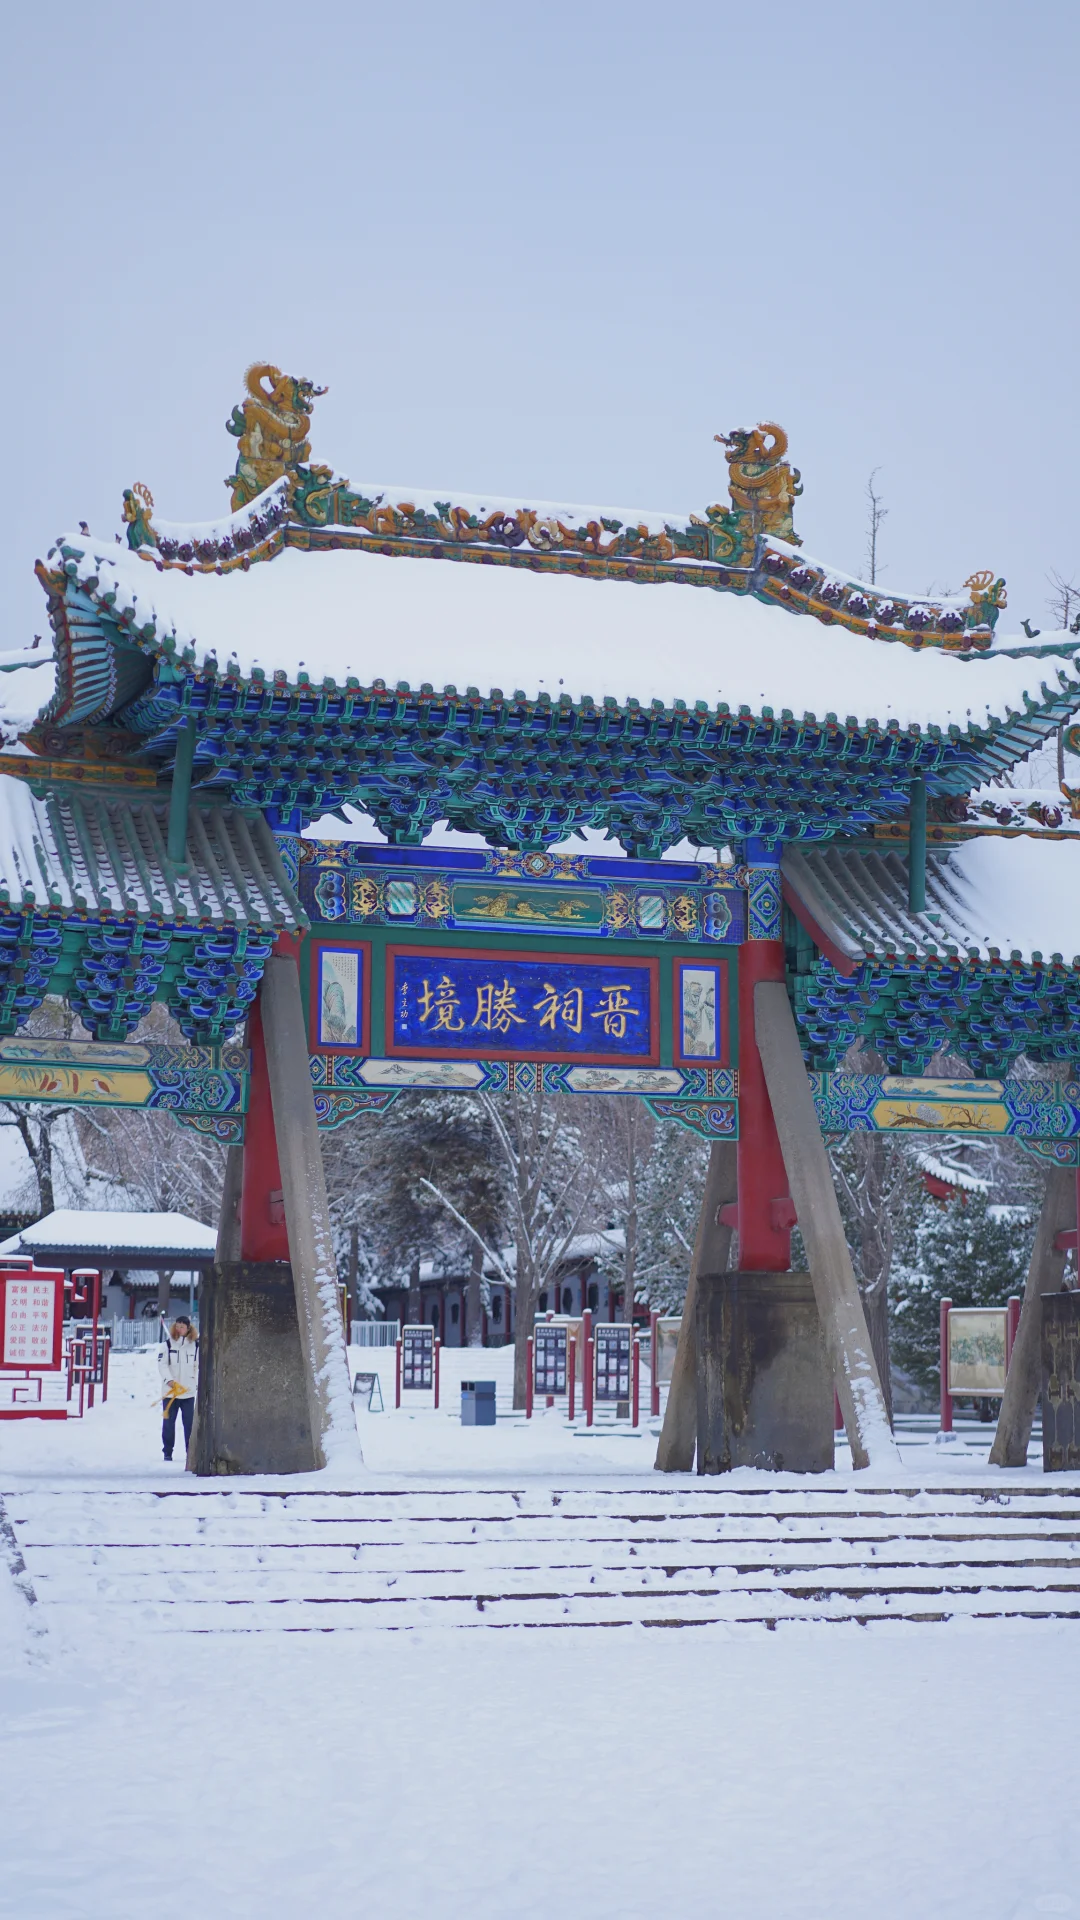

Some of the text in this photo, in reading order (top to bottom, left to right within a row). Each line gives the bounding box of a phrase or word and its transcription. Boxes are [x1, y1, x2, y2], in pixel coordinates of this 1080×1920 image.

[12, 1286, 49, 1294] 富强 民主
[11, 1298, 27, 1306] 文明
[11, 1311, 26, 1319] 自由
[32, 1324, 48, 1332] 法治
[9, 1349, 47, 1357] 诚信 友善
